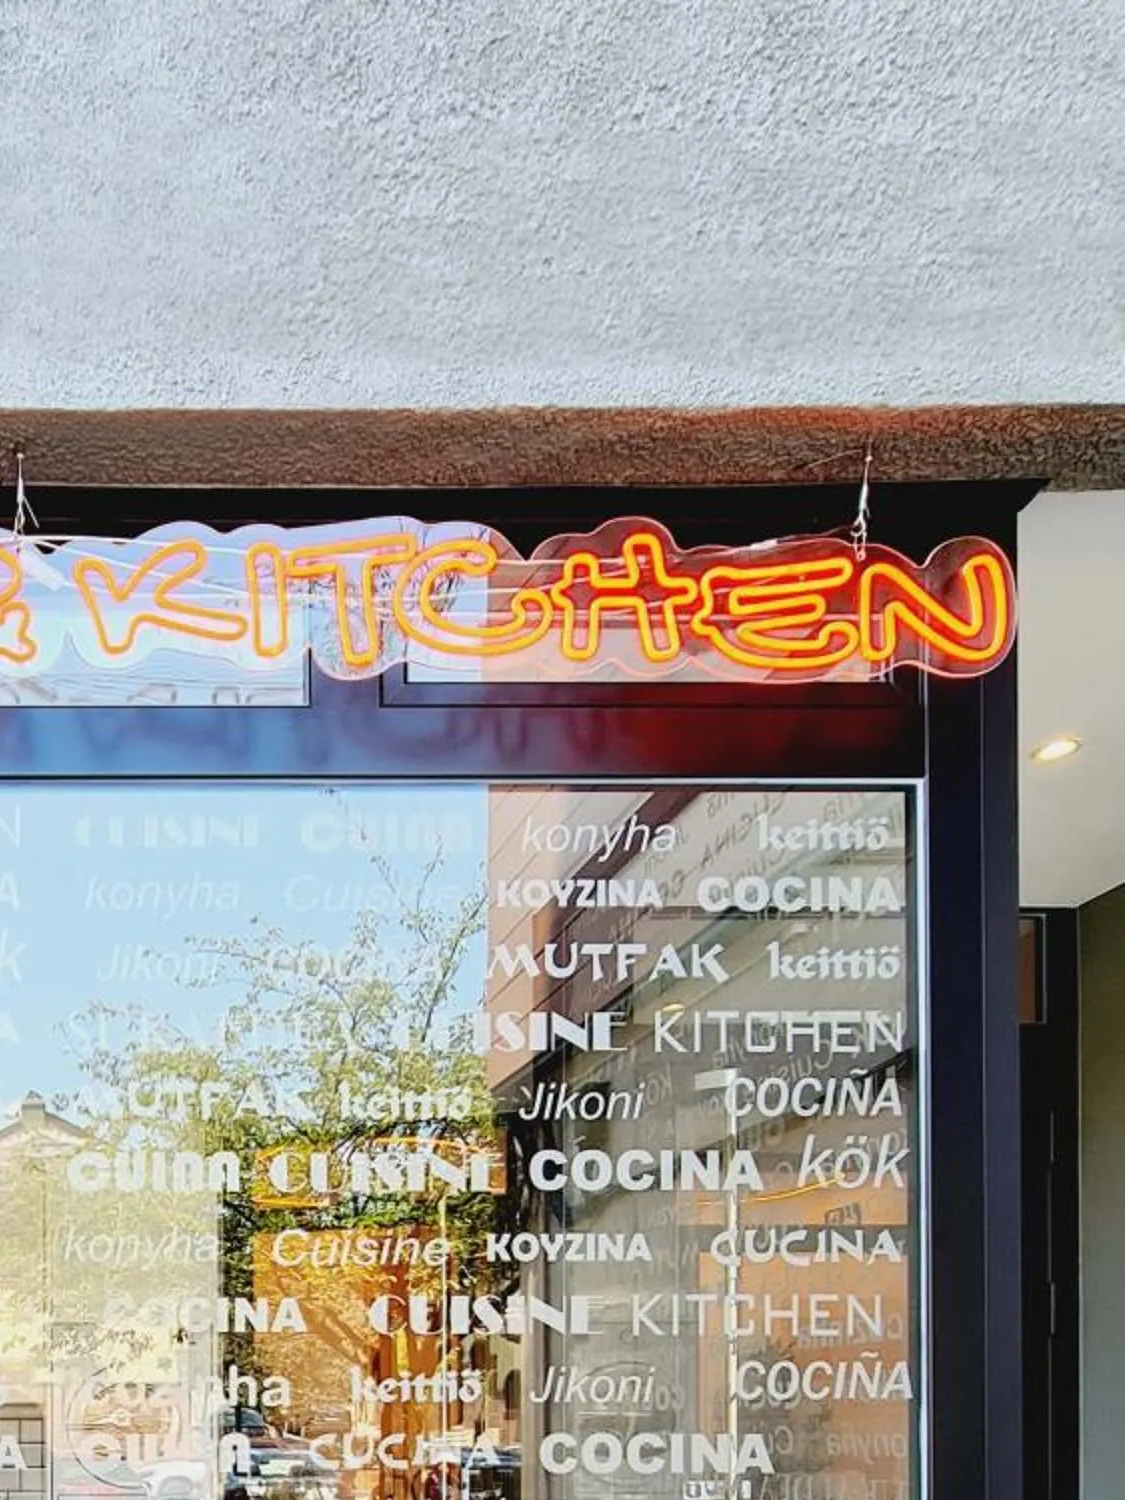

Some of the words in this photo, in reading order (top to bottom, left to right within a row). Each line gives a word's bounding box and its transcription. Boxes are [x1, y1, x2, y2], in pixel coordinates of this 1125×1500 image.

[74, 531, 1012, 667] KITCHEN
[521, 815, 678, 863] konyha
[758, 813, 889, 852] keittiö
[84, 873, 241, 921] konyha
[496, 878, 663, 908] KOYZINA
[696, 876, 904, 914] COCINA
[487, 942, 731, 984] MUTFAK
[767, 940, 901, 982] keittiö
[653, 1010, 903, 1053] KITCHEN
[517, 1082, 646, 1121] Jikoni
[724, 1068, 902, 1117] COCIÑA
[267, 1148, 506, 1194] CUISINE
[529, 1149, 764, 1191] COCINA
[797, 1134, 911, 1190] kök
[64, 1222, 222, 1272] konyha
[271, 1228, 450, 1268] Cuisine
[486, 1232, 651, 1263] KOYZINA
[711, 1229, 903, 1268] CUCINA
[369, 1295, 603, 1336] CUISINE
[633, 1294, 882, 1336] KITCHEN
[349, 1365, 482, 1404] keittiö
[529, 1367, 655, 1404] Jikoni
[733, 1351, 914, 1401] COCIÑA
[539, 1432, 775, 1475] COCINA
